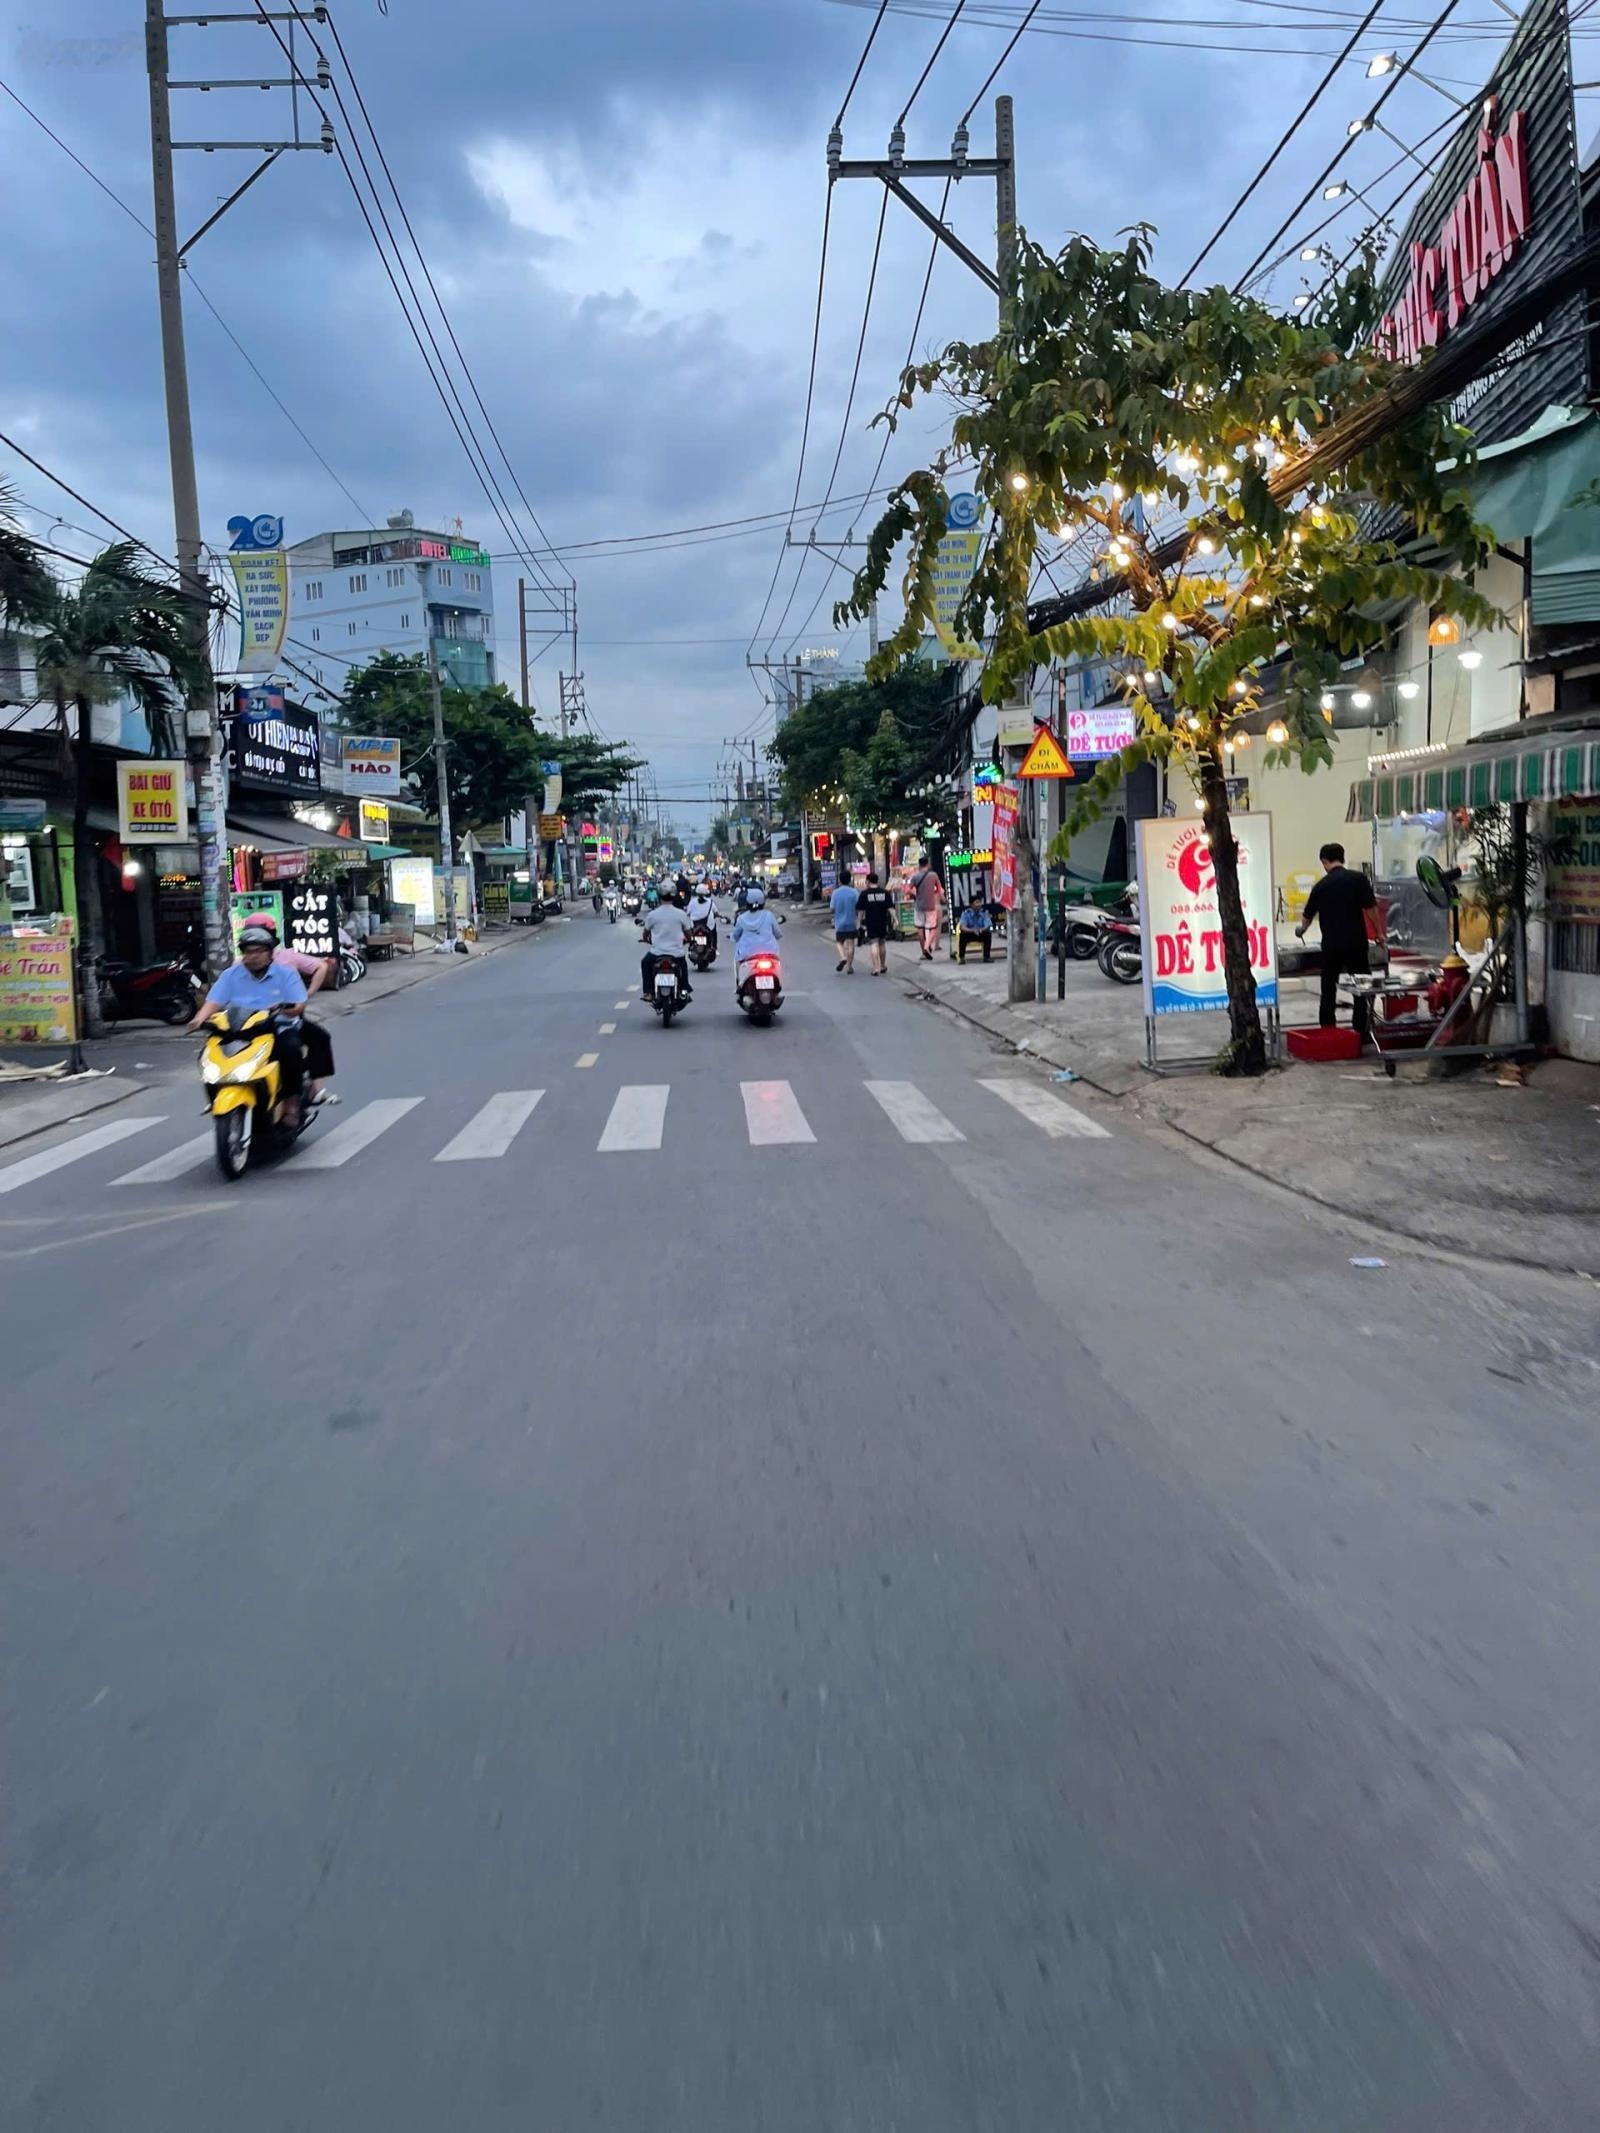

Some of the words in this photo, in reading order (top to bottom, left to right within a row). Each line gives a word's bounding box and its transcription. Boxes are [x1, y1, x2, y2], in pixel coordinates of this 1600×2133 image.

[1070, 732, 1090, 752] DÊ
[1039, 749, 1050, 757] ĐI
[351, 762, 391, 774] HÀO
[292, 888, 328, 911] CẮT
[292, 915, 330, 934] TÓC
[292, 937, 333, 953] NAM
[1156, 919, 1194, 976] DÊ
[1201, 918, 1270, 972] TƠI
